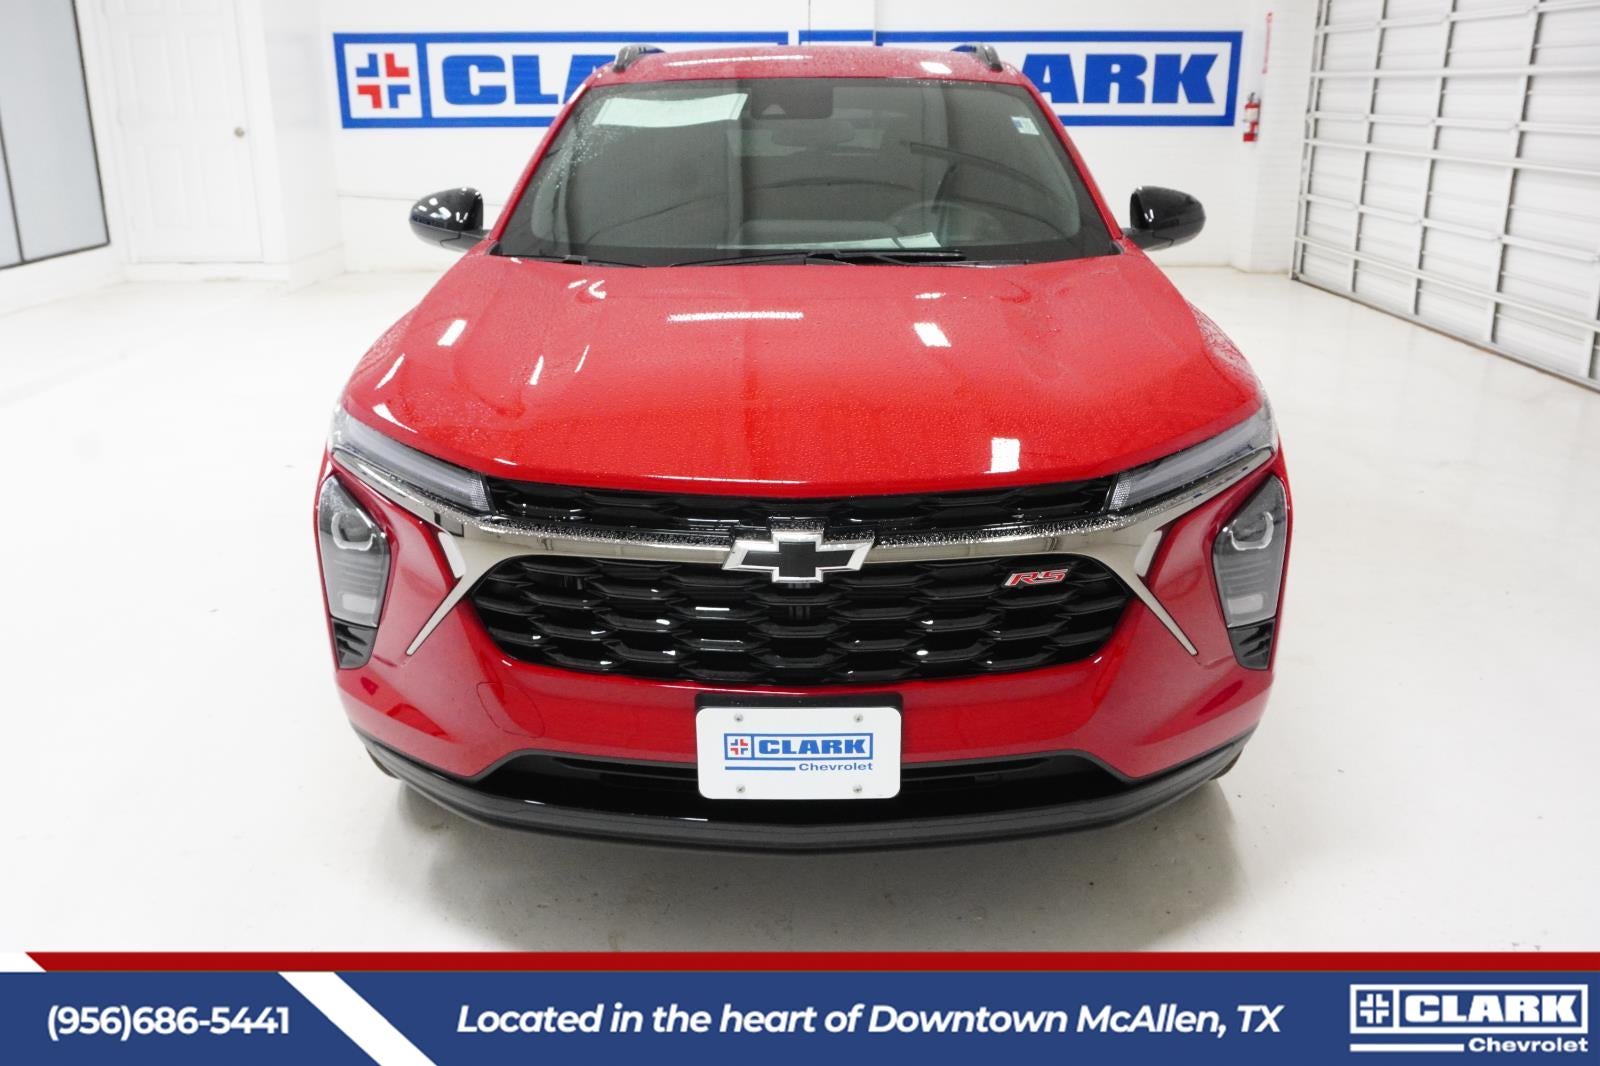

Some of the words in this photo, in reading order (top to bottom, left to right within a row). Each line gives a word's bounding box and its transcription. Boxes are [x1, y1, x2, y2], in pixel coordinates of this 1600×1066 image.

[1004, 569, 1068, 586] RS
[758, 739, 866, 755] CLARK
[799, 762, 873, 772] Chevrolet
